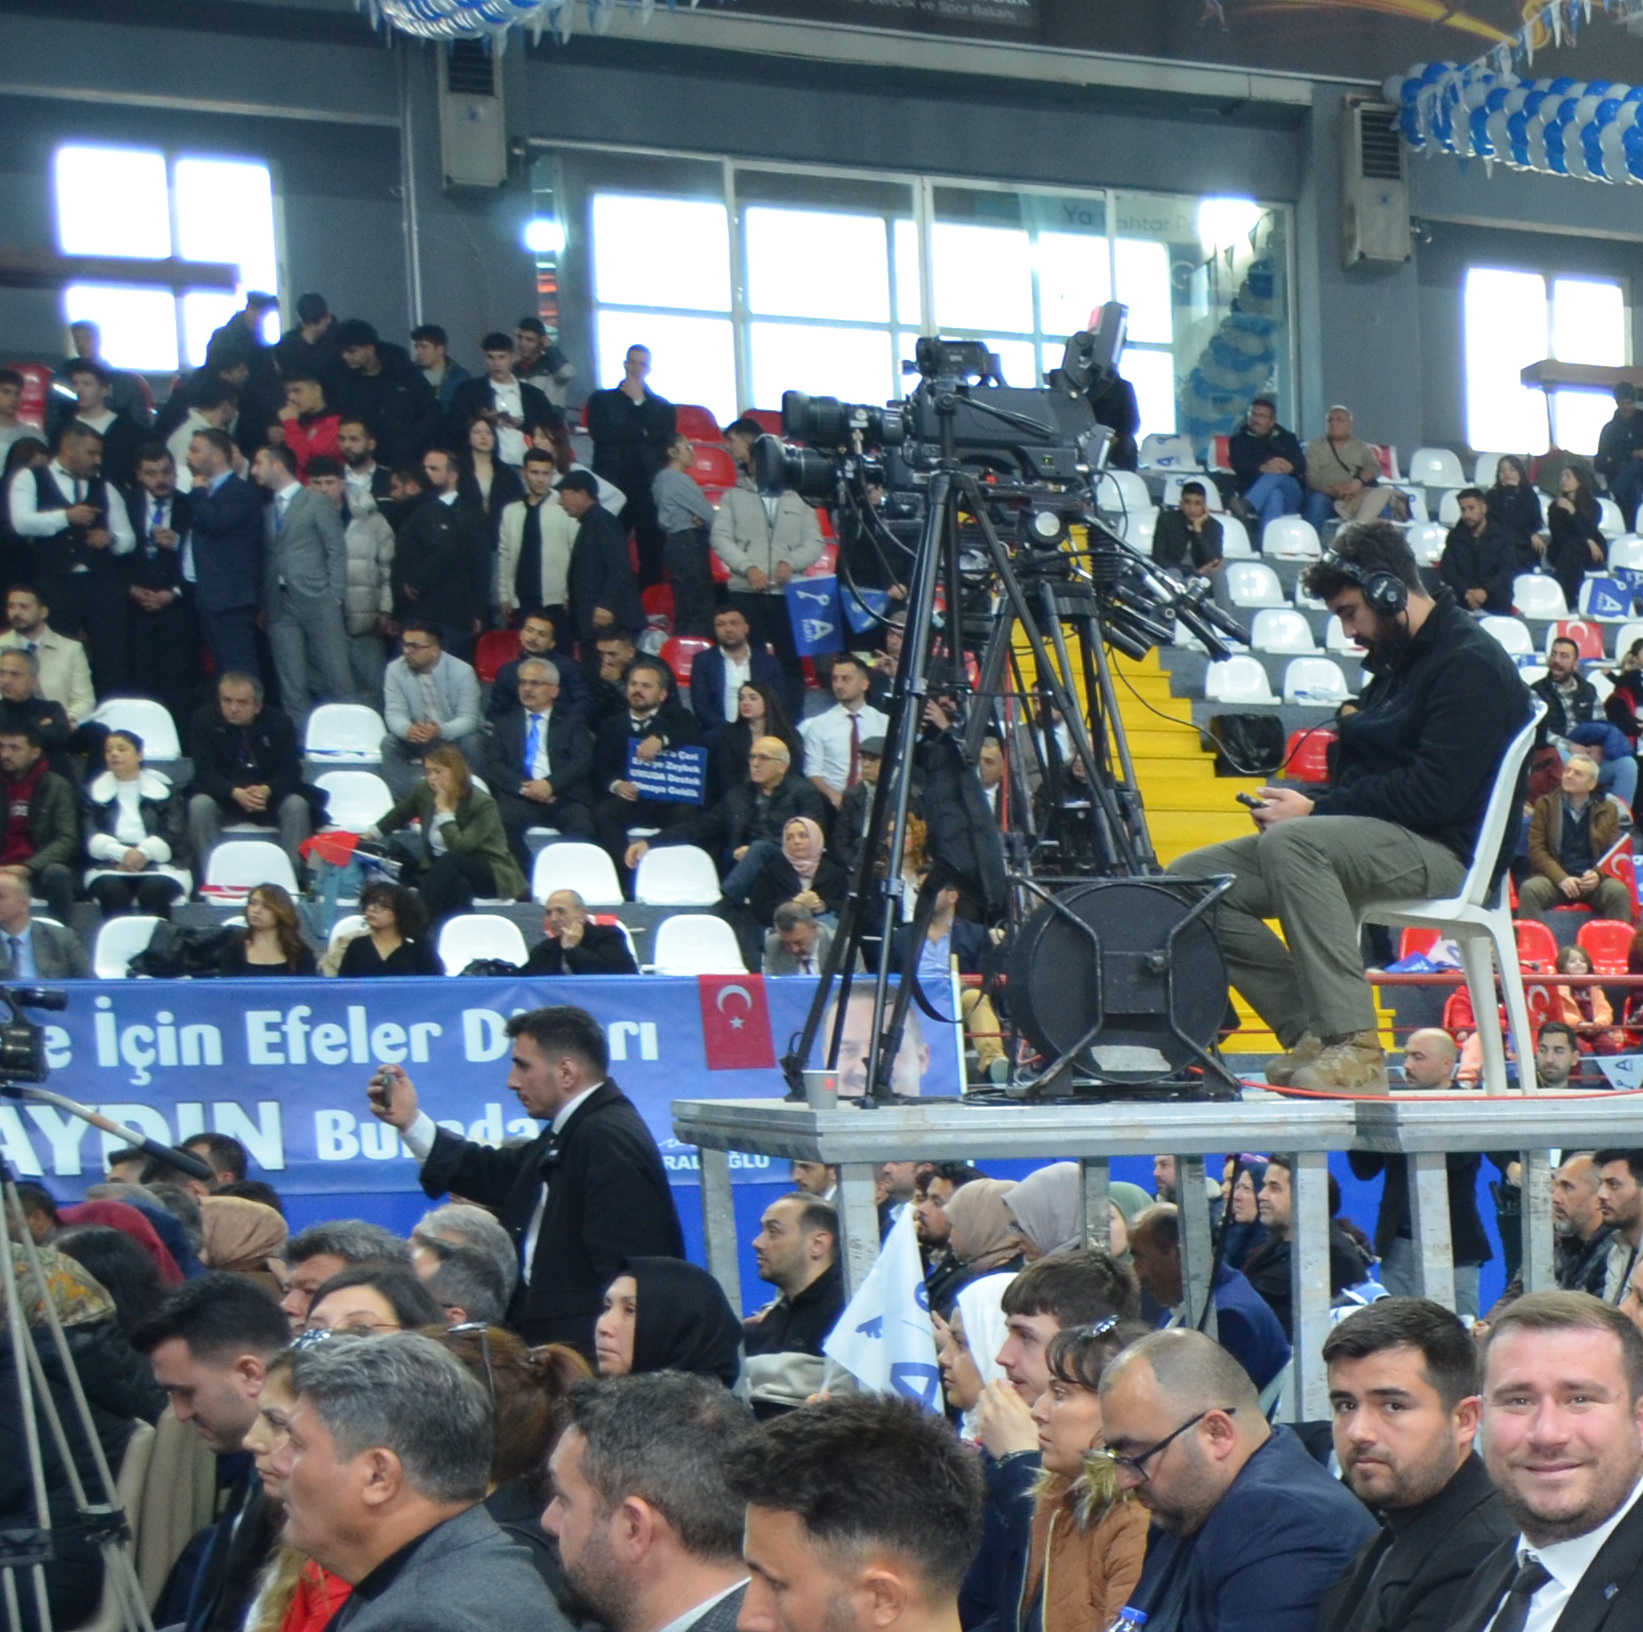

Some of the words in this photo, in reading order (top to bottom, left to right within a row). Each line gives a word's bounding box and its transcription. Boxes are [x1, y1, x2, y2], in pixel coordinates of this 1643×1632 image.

[94, 995, 223, 1086] İçin
[246, 1004, 443, 1066] Efeler
[462, 1007, 658, 1063] Drı
[0, 1101, 285, 1177] AYDIN
[315, 1103, 541, 1162] Buda
